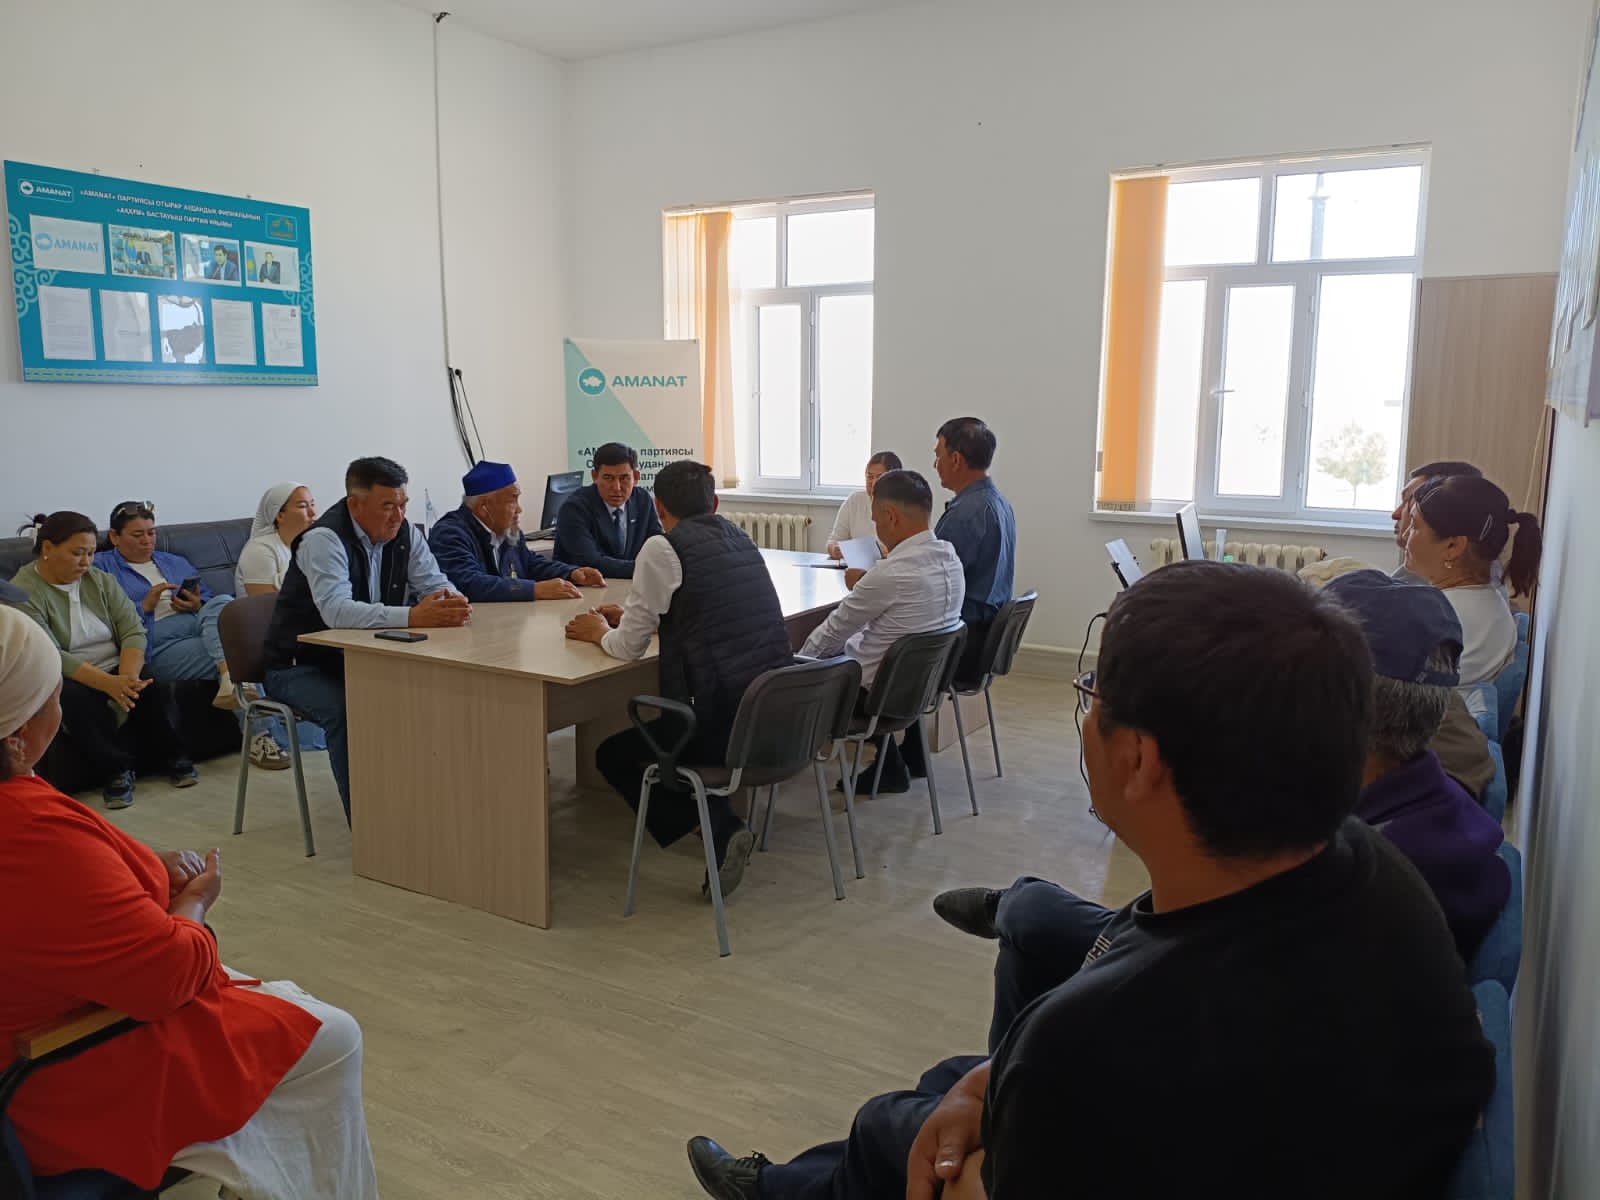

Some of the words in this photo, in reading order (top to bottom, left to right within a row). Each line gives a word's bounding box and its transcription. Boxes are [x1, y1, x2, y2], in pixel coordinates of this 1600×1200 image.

[36, 185, 72, 198] AMANAT
[54, 239, 99, 253] AMANAT
[611, 375, 687, 387] AMANAT
[640, 448, 694, 457] партиясы
